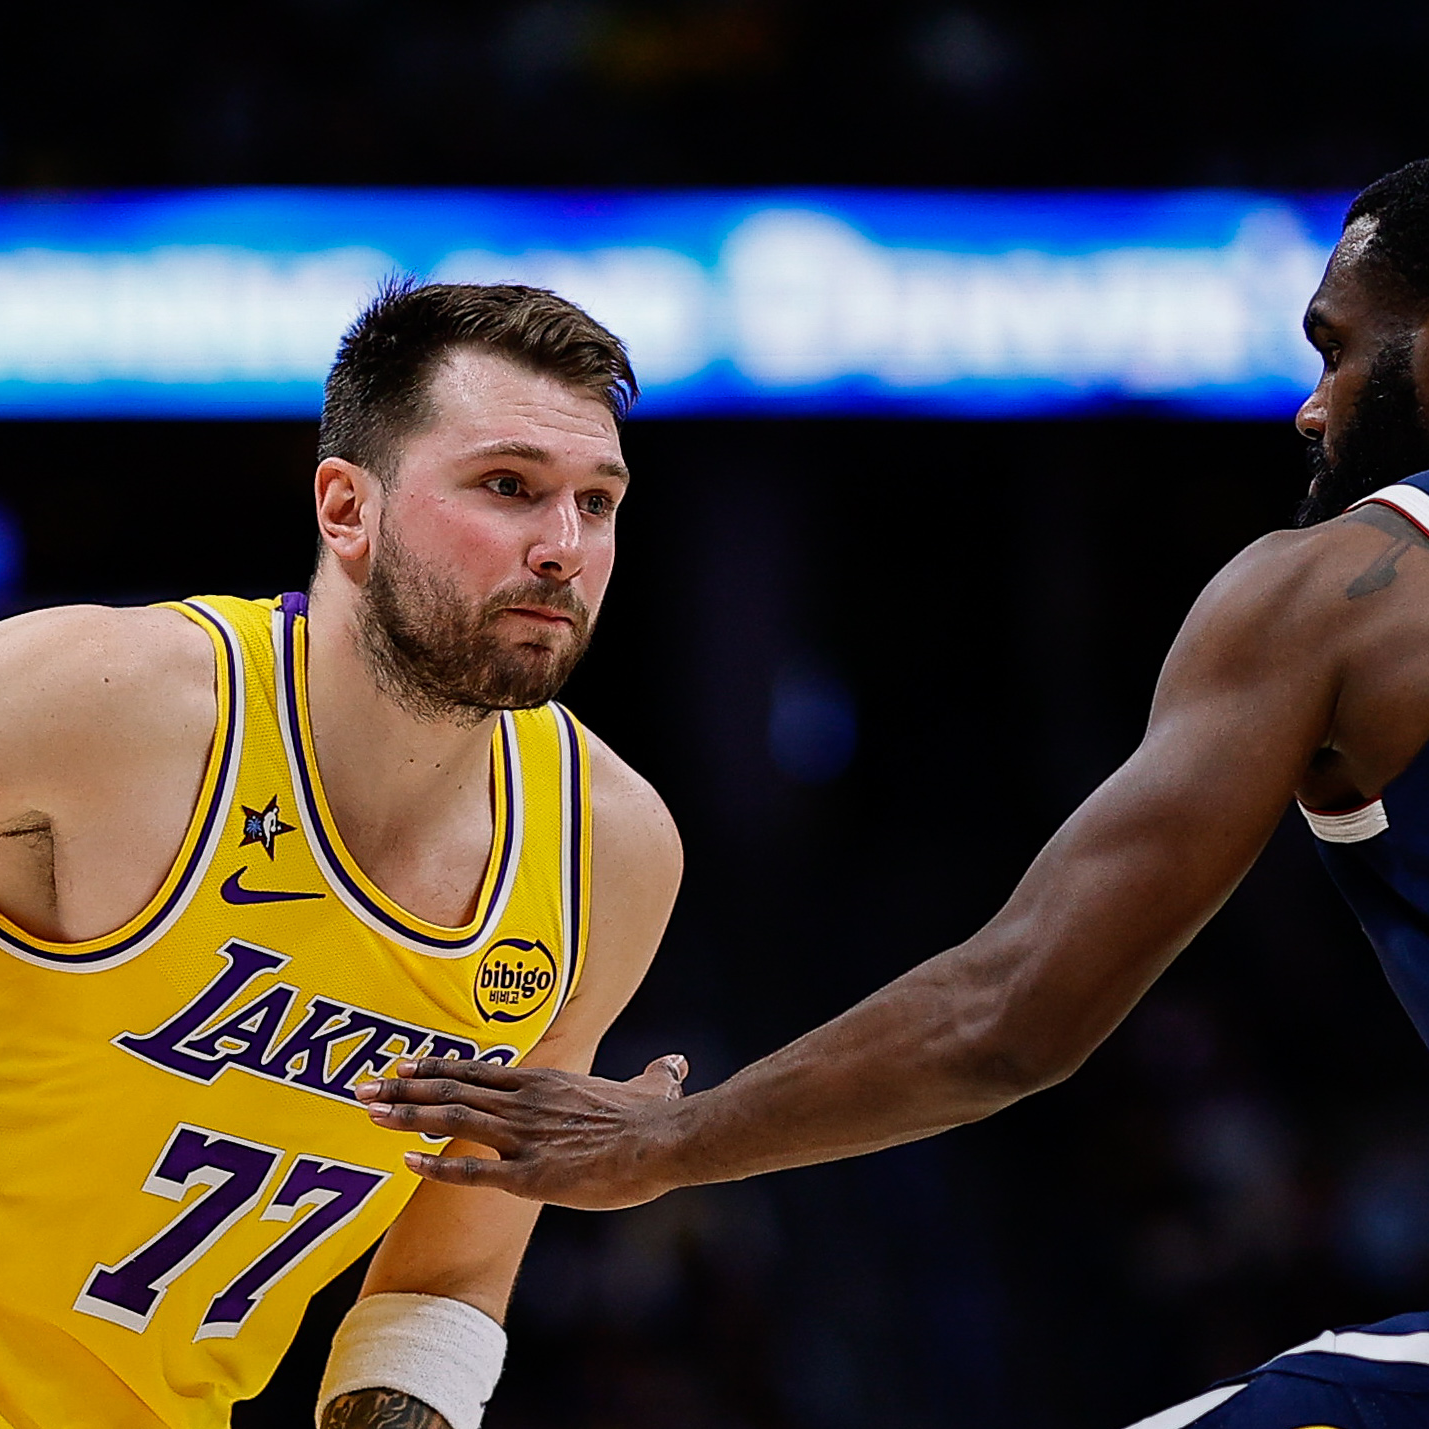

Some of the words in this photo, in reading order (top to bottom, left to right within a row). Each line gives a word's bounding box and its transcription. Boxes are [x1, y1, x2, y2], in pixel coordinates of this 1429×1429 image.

[480, 960, 551, 999] bibigo
[489, 990, 519, 1005] 비비고
[73, 1122, 394, 1343] 77
